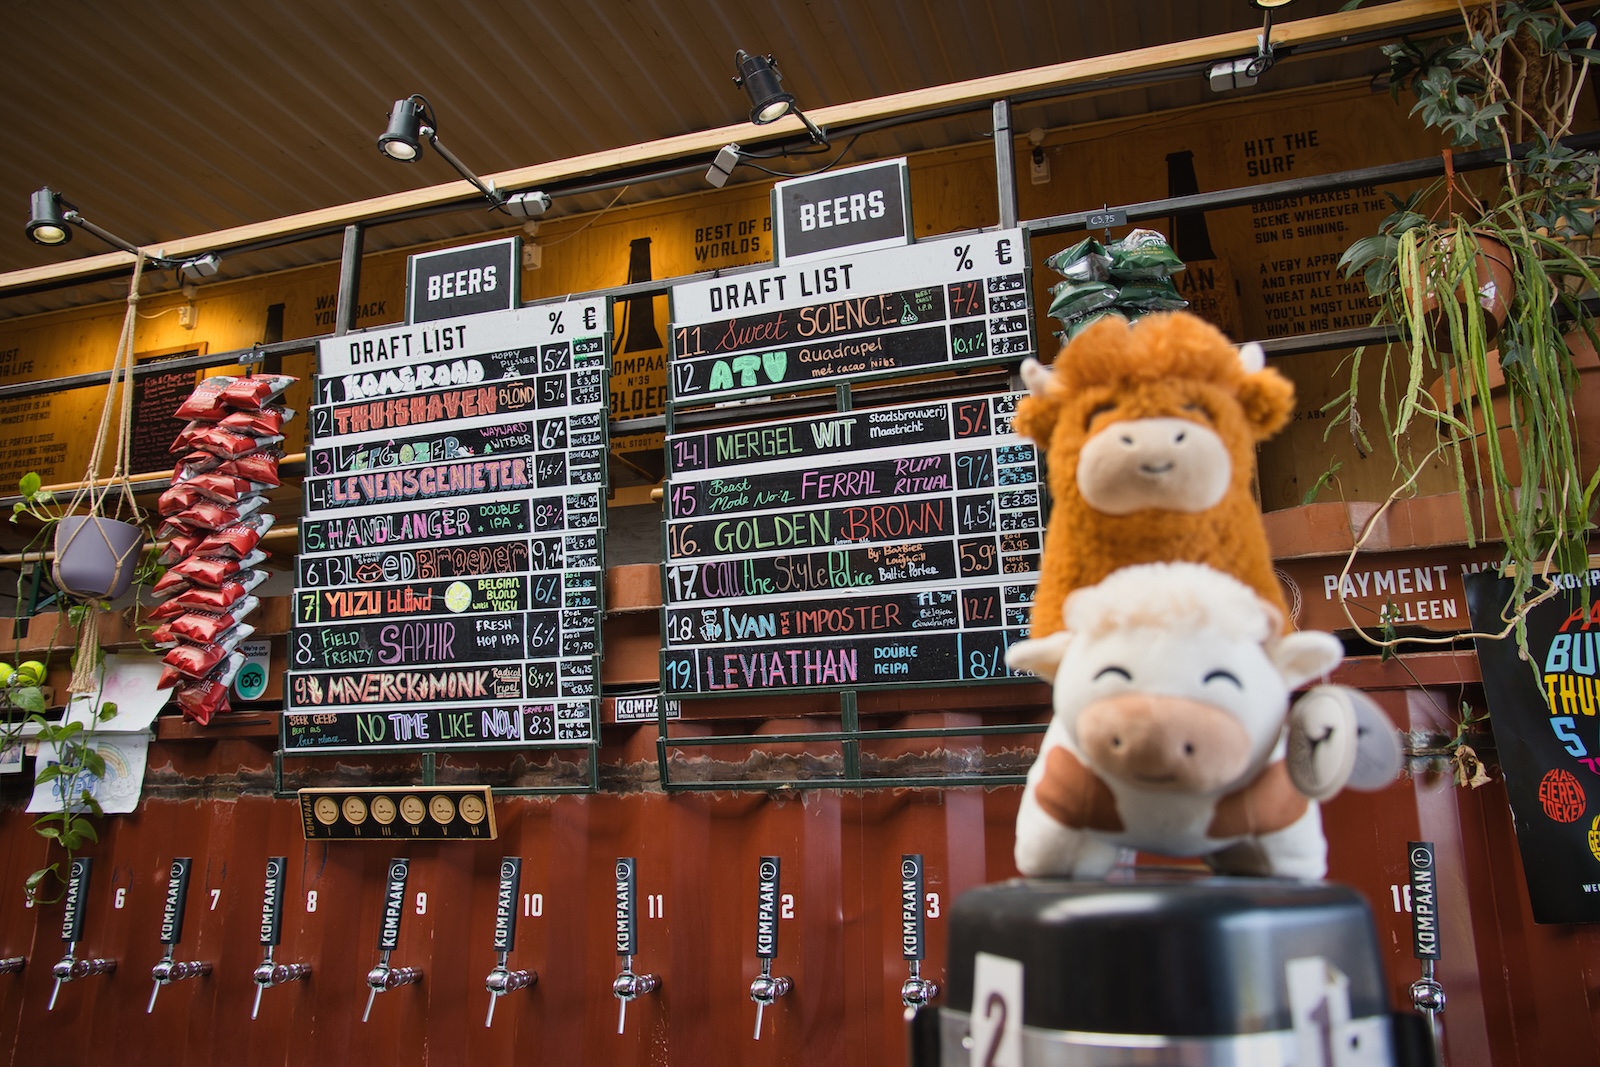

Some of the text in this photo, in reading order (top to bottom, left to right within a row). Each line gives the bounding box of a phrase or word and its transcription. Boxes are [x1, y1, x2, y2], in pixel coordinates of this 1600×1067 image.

[1244, 130, 1320, 158] HIT THE
[1246, 154, 1295, 177] SURF
[800, 190, 886, 232] BEERS
[1253, 199, 1386, 229] SCENE WHEREVER THE
[695, 219, 757, 243] BEST OF
[1255, 228, 1294, 244] SUN IS
[695, 237, 760, 261] WORLDS
[710, 239, 1012, 312] DRAFT LIST % €
[1271, 258, 1301, 272] VERY
[427, 265, 498, 301] BEERS
[990, 282, 1021, 291] €5.10
[1261, 275, 1286, 290] AND
[1289, 271, 1330, 286] FRUITY
[950, 282, 979, 314] 7%
[992, 300, 1024, 313] €9.95
[1263, 286, 1332, 304] WHEAT ALE
[1310, 300, 1343, 317] MOST
[715, 312, 789, 351] Sweet
[797, 293, 897, 337] SCIENCE
[1266, 318, 1329, 337] HIM IN HIS
[350, 306, 597, 365] DRAFT LIST % €
[992, 342, 1025, 354] €8.15
[491, 350, 521, 361] HOPPY
[500, 356, 536, 368] PILSNER
[544, 348, 568, 372] 5%
[676, 337, 883, 394] 12. ATV Quadrupel
[811, 362, 866, 377] met cacao
[544, 380, 565, 402] 5%
[334, 386, 535, 434] THUISHAVEN BLOND
[958, 401, 987, 436] 5%
[479, 422, 528, 438] WAYWARD
[490, 434, 532, 449] WITBIER
[541, 420, 565, 449] 6%
[869, 421, 925, 439] Maastricht
[674, 419, 857, 467] 14. MERGEL WIT
[893, 455, 942, 476] RUM
[997, 451, 1032, 464] €5.55
[333, 459, 528, 506] LEVENSGENIETER
[957, 454, 989, 488] 9%
[672, 470, 881, 516] 15 FERRAL
[709, 478, 752, 496] Beast
[893, 473, 952, 495] RITUAL
[479, 503, 521, 517] DOUBLE
[709, 492, 749, 512] Mode
[1000, 494, 1037, 508] €3.85
[328, 508, 472, 550] HANDLANGER
[490, 517, 512, 529] IPA
[670, 500, 944, 558] 16. GOLDEN BROWN
[1001, 518, 1036, 530] €7.65
[477, 577, 521, 590] BELGIAN
[703, 561, 744, 598] Call
[744, 558, 775, 595] the
[773, 553, 828, 592] Style
[827, 550, 874, 588] Police
[878, 566, 907, 582] Baltic
[1323, 565, 1449, 601] PAYMENT
[535, 577, 557, 604] 6%
[325, 590, 382, 617] YUZU
[491, 599, 518, 612] YUSU
[963, 596, 994, 621] 12%
[476, 618, 512, 632] FRESH
[532, 622, 556, 648] 6%
[668, 603, 902, 642] 18. IVAN THE IMPOSTER
[377, 621, 456, 664] SAPHIR
[476, 633, 520, 648] HOP IPA
[874, 645, 918, 659] DOUBLE
[321, 649, 373, 667] FRENZY
[666, 649, 858, 690] 19. LEVIATHAN
[969, 645, 1002, 679] 8%
[429, 670, 490, 701] MONK
[528, 666, 554, 688] 8,4%
[356, 708, 520, 744] NO TIME LIKE NOW
[529, 715, 552, 735] 8,3
[1542, 767, 1577, 782] PAAS
[1538, 780, 1586, 806] EIEREN
[301, 794, 315, 837] KOMPAAN
[1539, 797, 1587, 823] ZOEKEN
[61, 877, 80, 940] KOMPAAN
[114, 888, 126, 909] 6
[160, 877, 181, 941] KOMPAAN
[210, 889, 221, 911] 7
[260, 878, 277, 943] KOMPAAN
[306, 890, 318, 912] 8
[415, 892, 427, 915] 9
[523, 893, 543, 917] 10
[648, 894, 663, 919] 11
[781, 894, 794, 919] 2
[926, 892, 940, 918] 3
[382, 881, 405, 948] KOMPAAN
[494, 880, 512, 948] KOMPAAN
[616, 881, 629, 952] KOMPAAN
[758, 882, 774, 954] KOMPAAN
[902, 881, 917, 956] KOMPAAN
[1414, 870, 1436, 955] KOMPAAN
